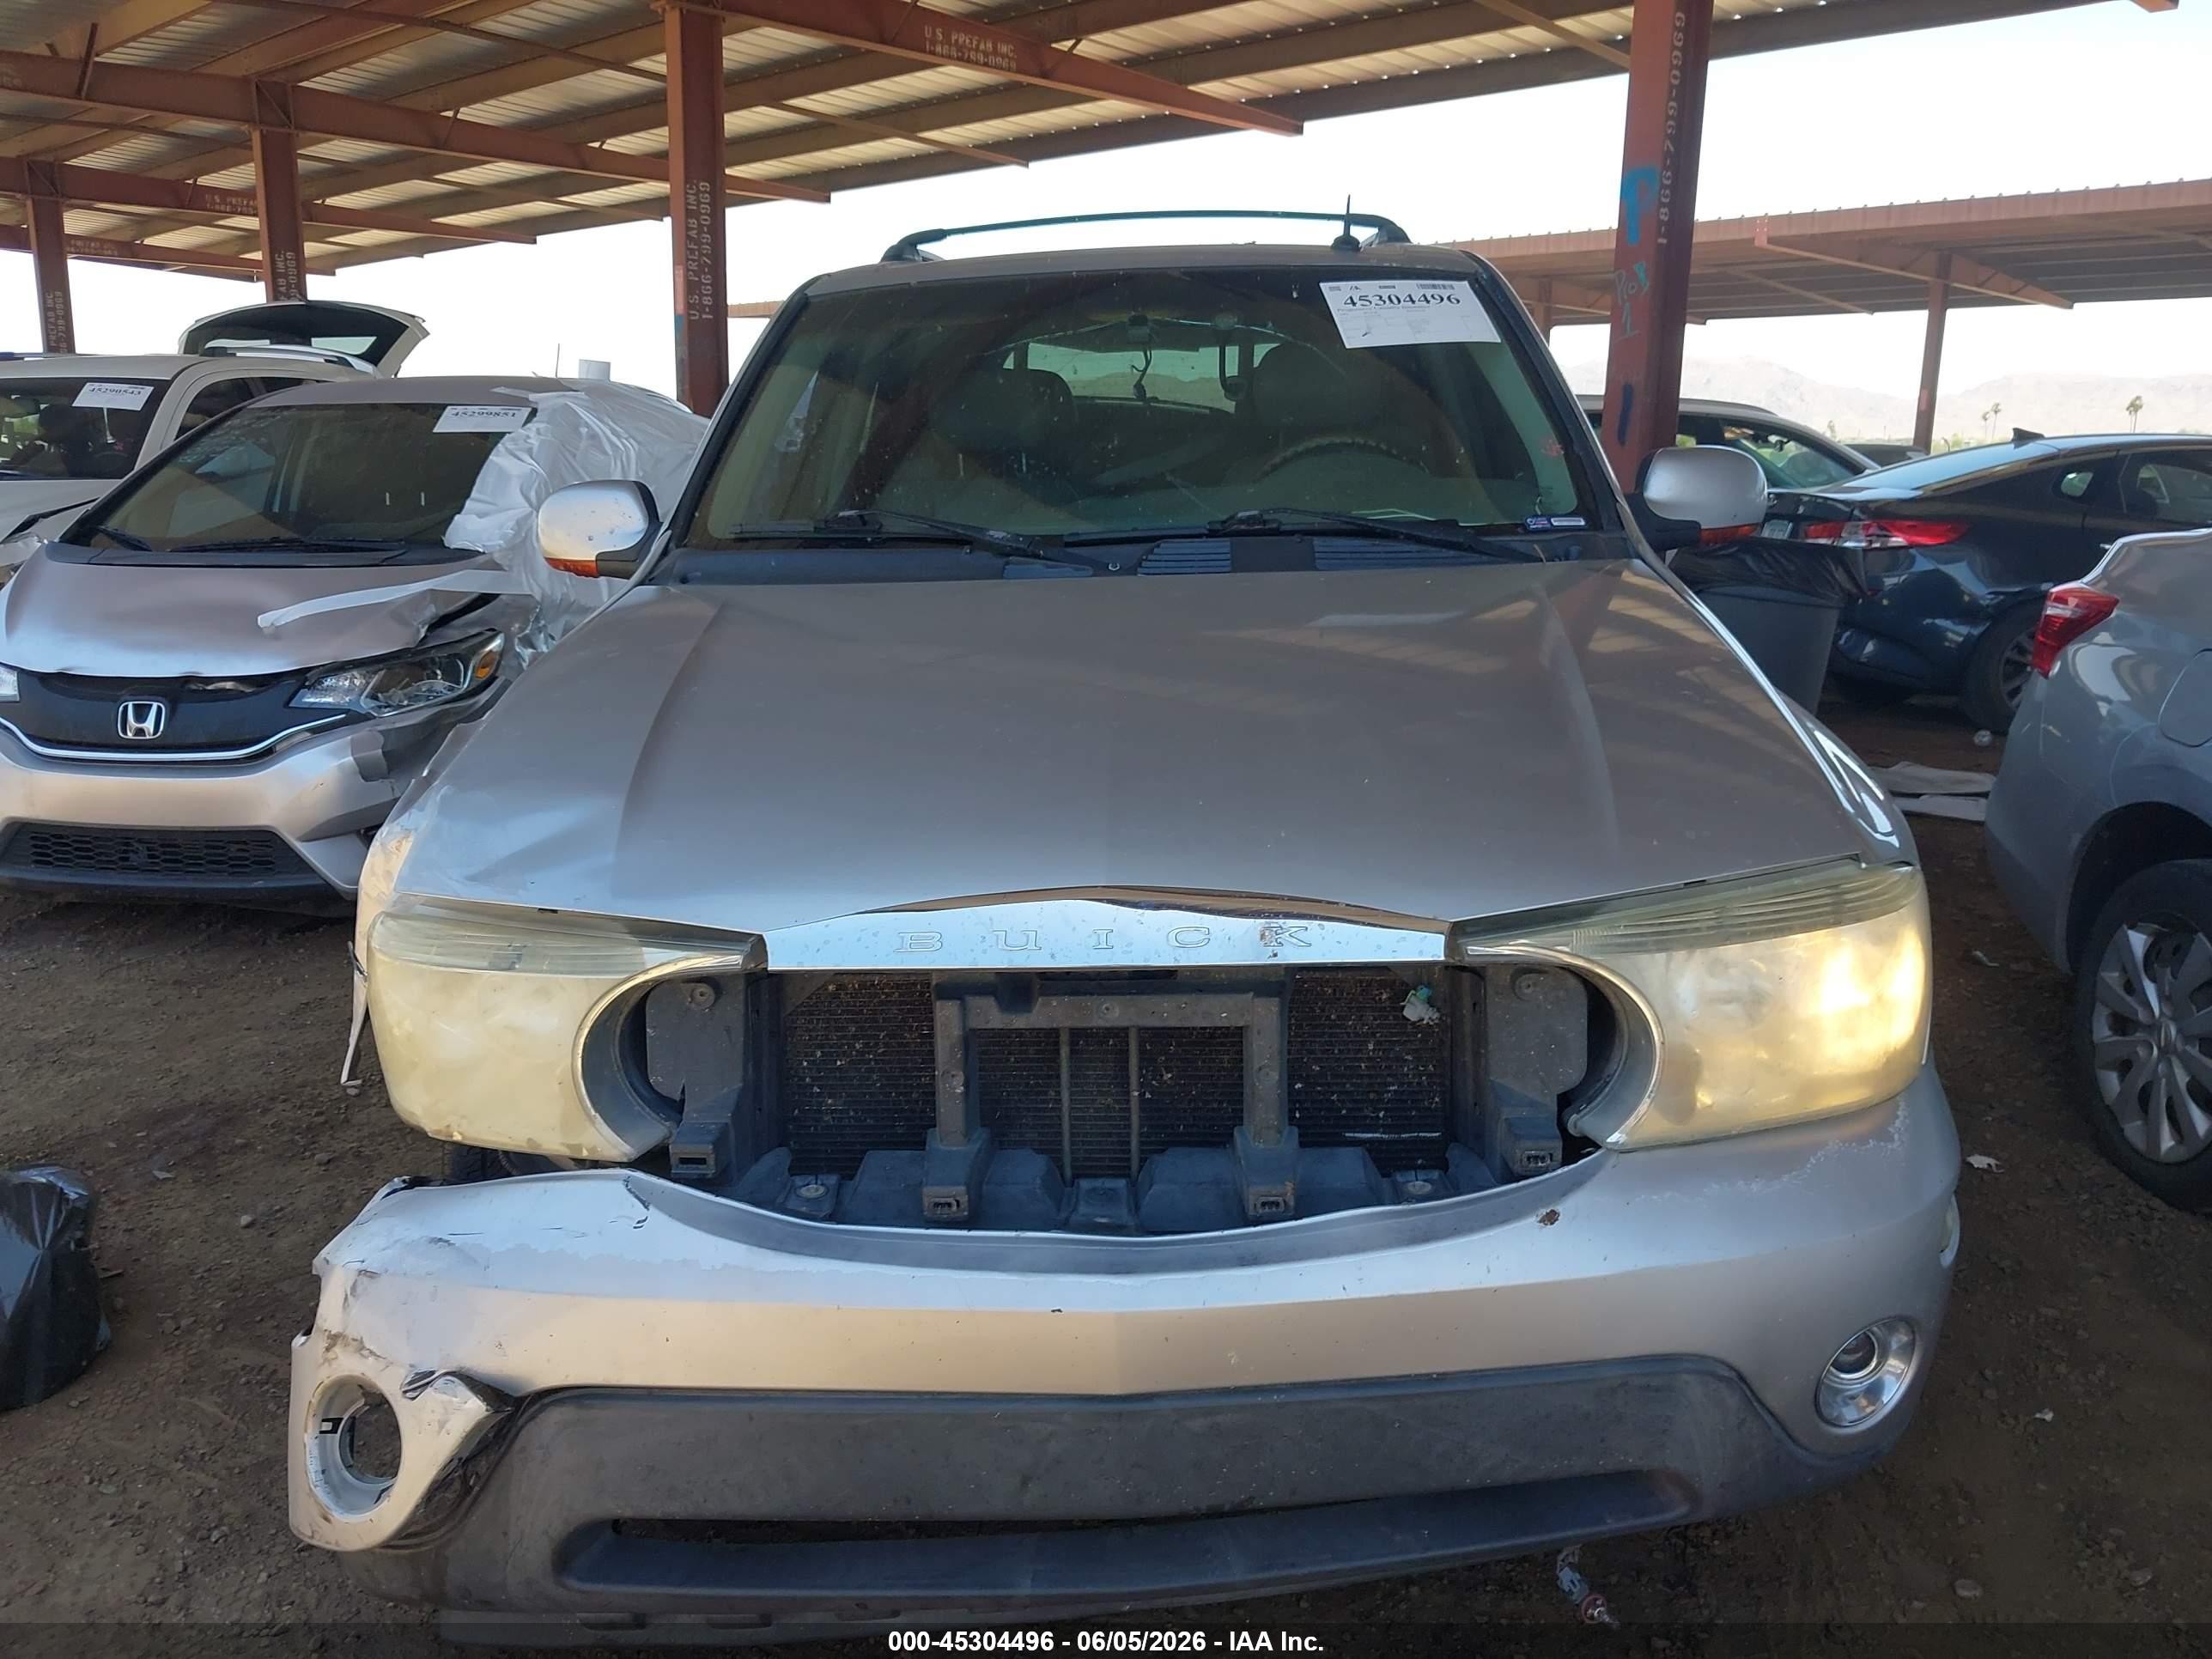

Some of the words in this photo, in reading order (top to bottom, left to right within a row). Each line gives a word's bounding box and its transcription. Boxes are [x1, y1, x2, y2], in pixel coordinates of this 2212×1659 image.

[951, 30, 994, 52] PREFAB
[996, 40, 1018, 58] INC.
[1656, 11, 1686, 244] 1-866-799-0969
[686, 179, 697, 210] INC.
[687, 218, 700, 282] PREFAB
[699, 181, 714, 319] 1-866-799-0969
[1343, 293, 1461, 307] 45304496
[894, 924, 1312, 953] BUICK
